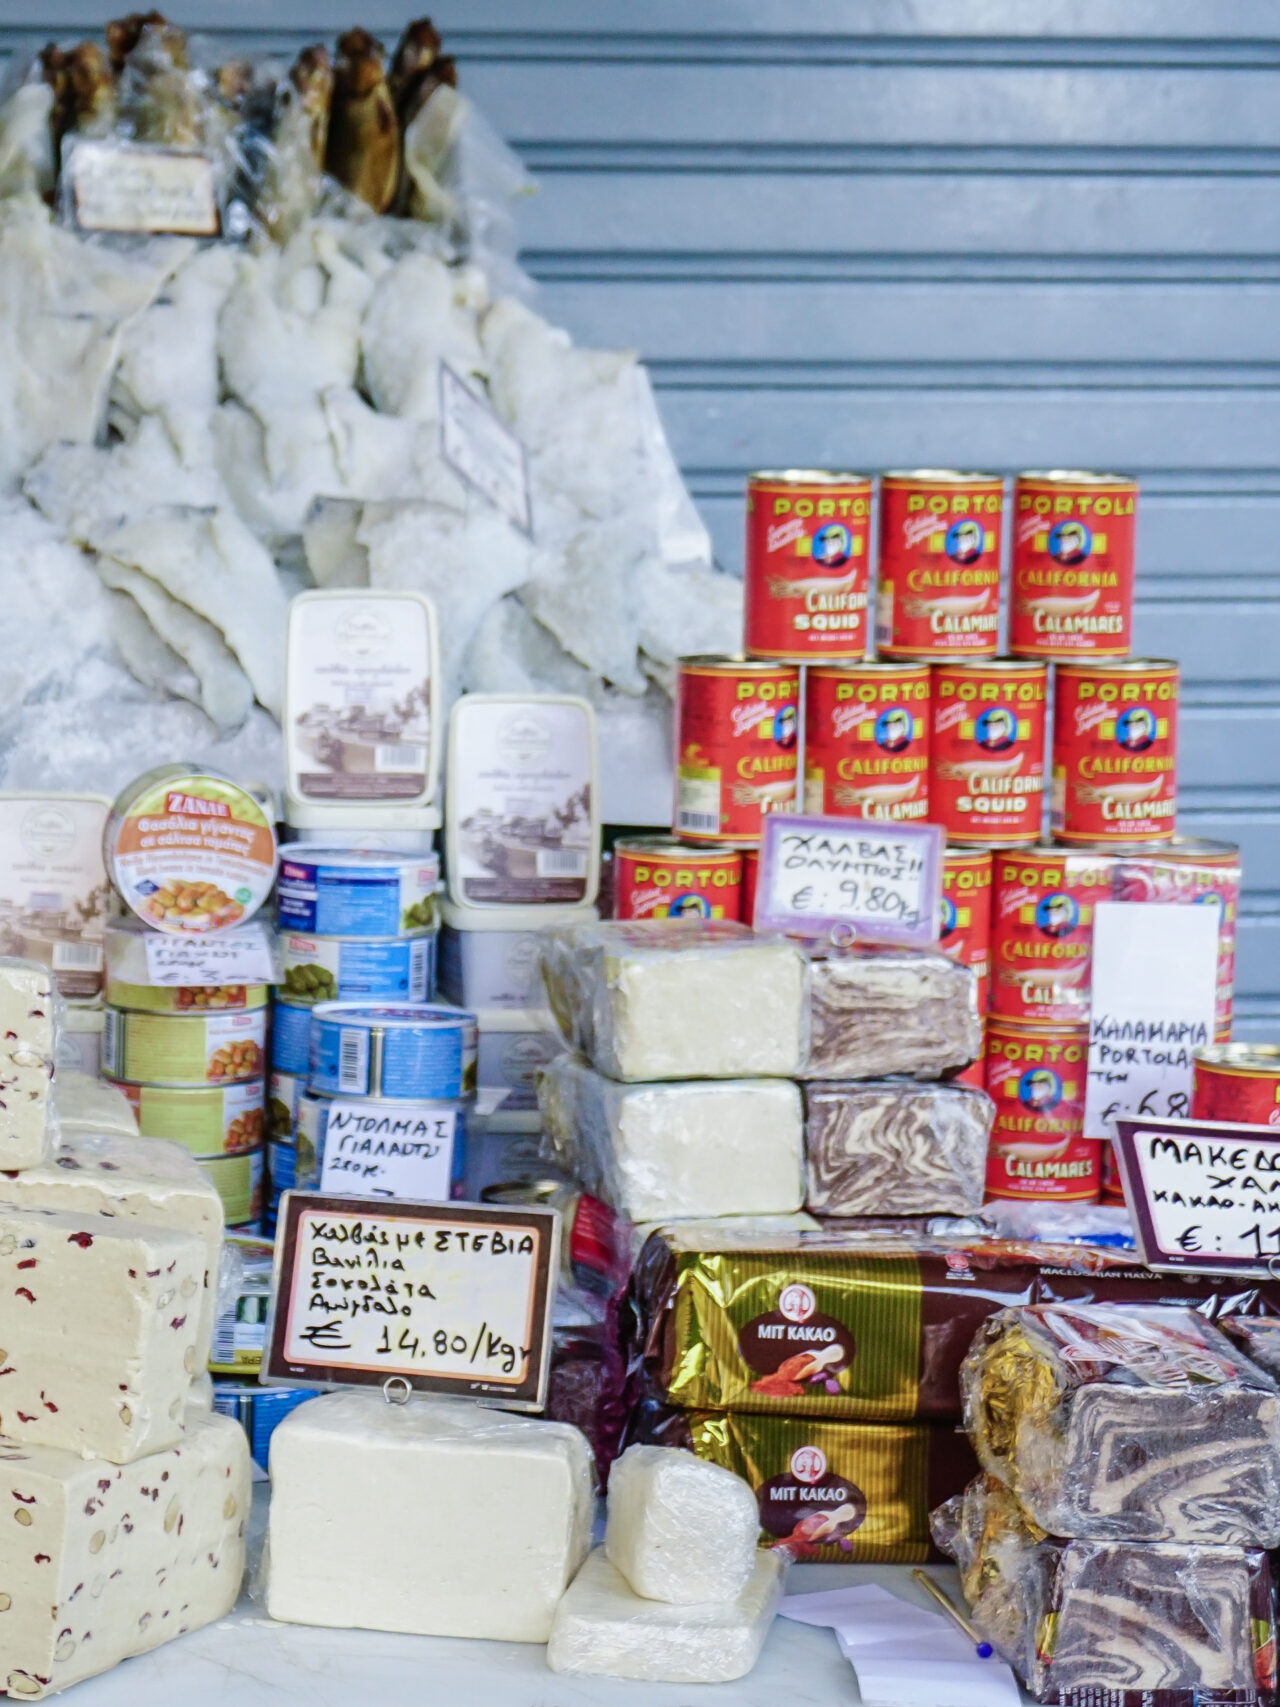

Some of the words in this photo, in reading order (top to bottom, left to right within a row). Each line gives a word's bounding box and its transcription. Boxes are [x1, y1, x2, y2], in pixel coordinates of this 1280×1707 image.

[774, 498, 870, 518] PORTO
[907, 494, 1002, 515] PORTO
[793, 613, 860, 631] SQUID
[1034, 609, 1124, 634] CALAMARES
[168, 793, 229, 817] ZANAE
[956, 796, 1028, 813] SQUID
[783, 834, 908, 862] ΧΑΛΒΑΣ
[1005, 1154, 1093, 1179] CALAMARES
[434, 1230, 534, 1255] ΣΤΕΒΙΑ
[758, 1323, 784, 1340] MIT
[787, 1325, 837, 1342] KAKAO
[770, 1486, 796, 1502] MIT
[799, 1487, 848, 1502] KAKAO
